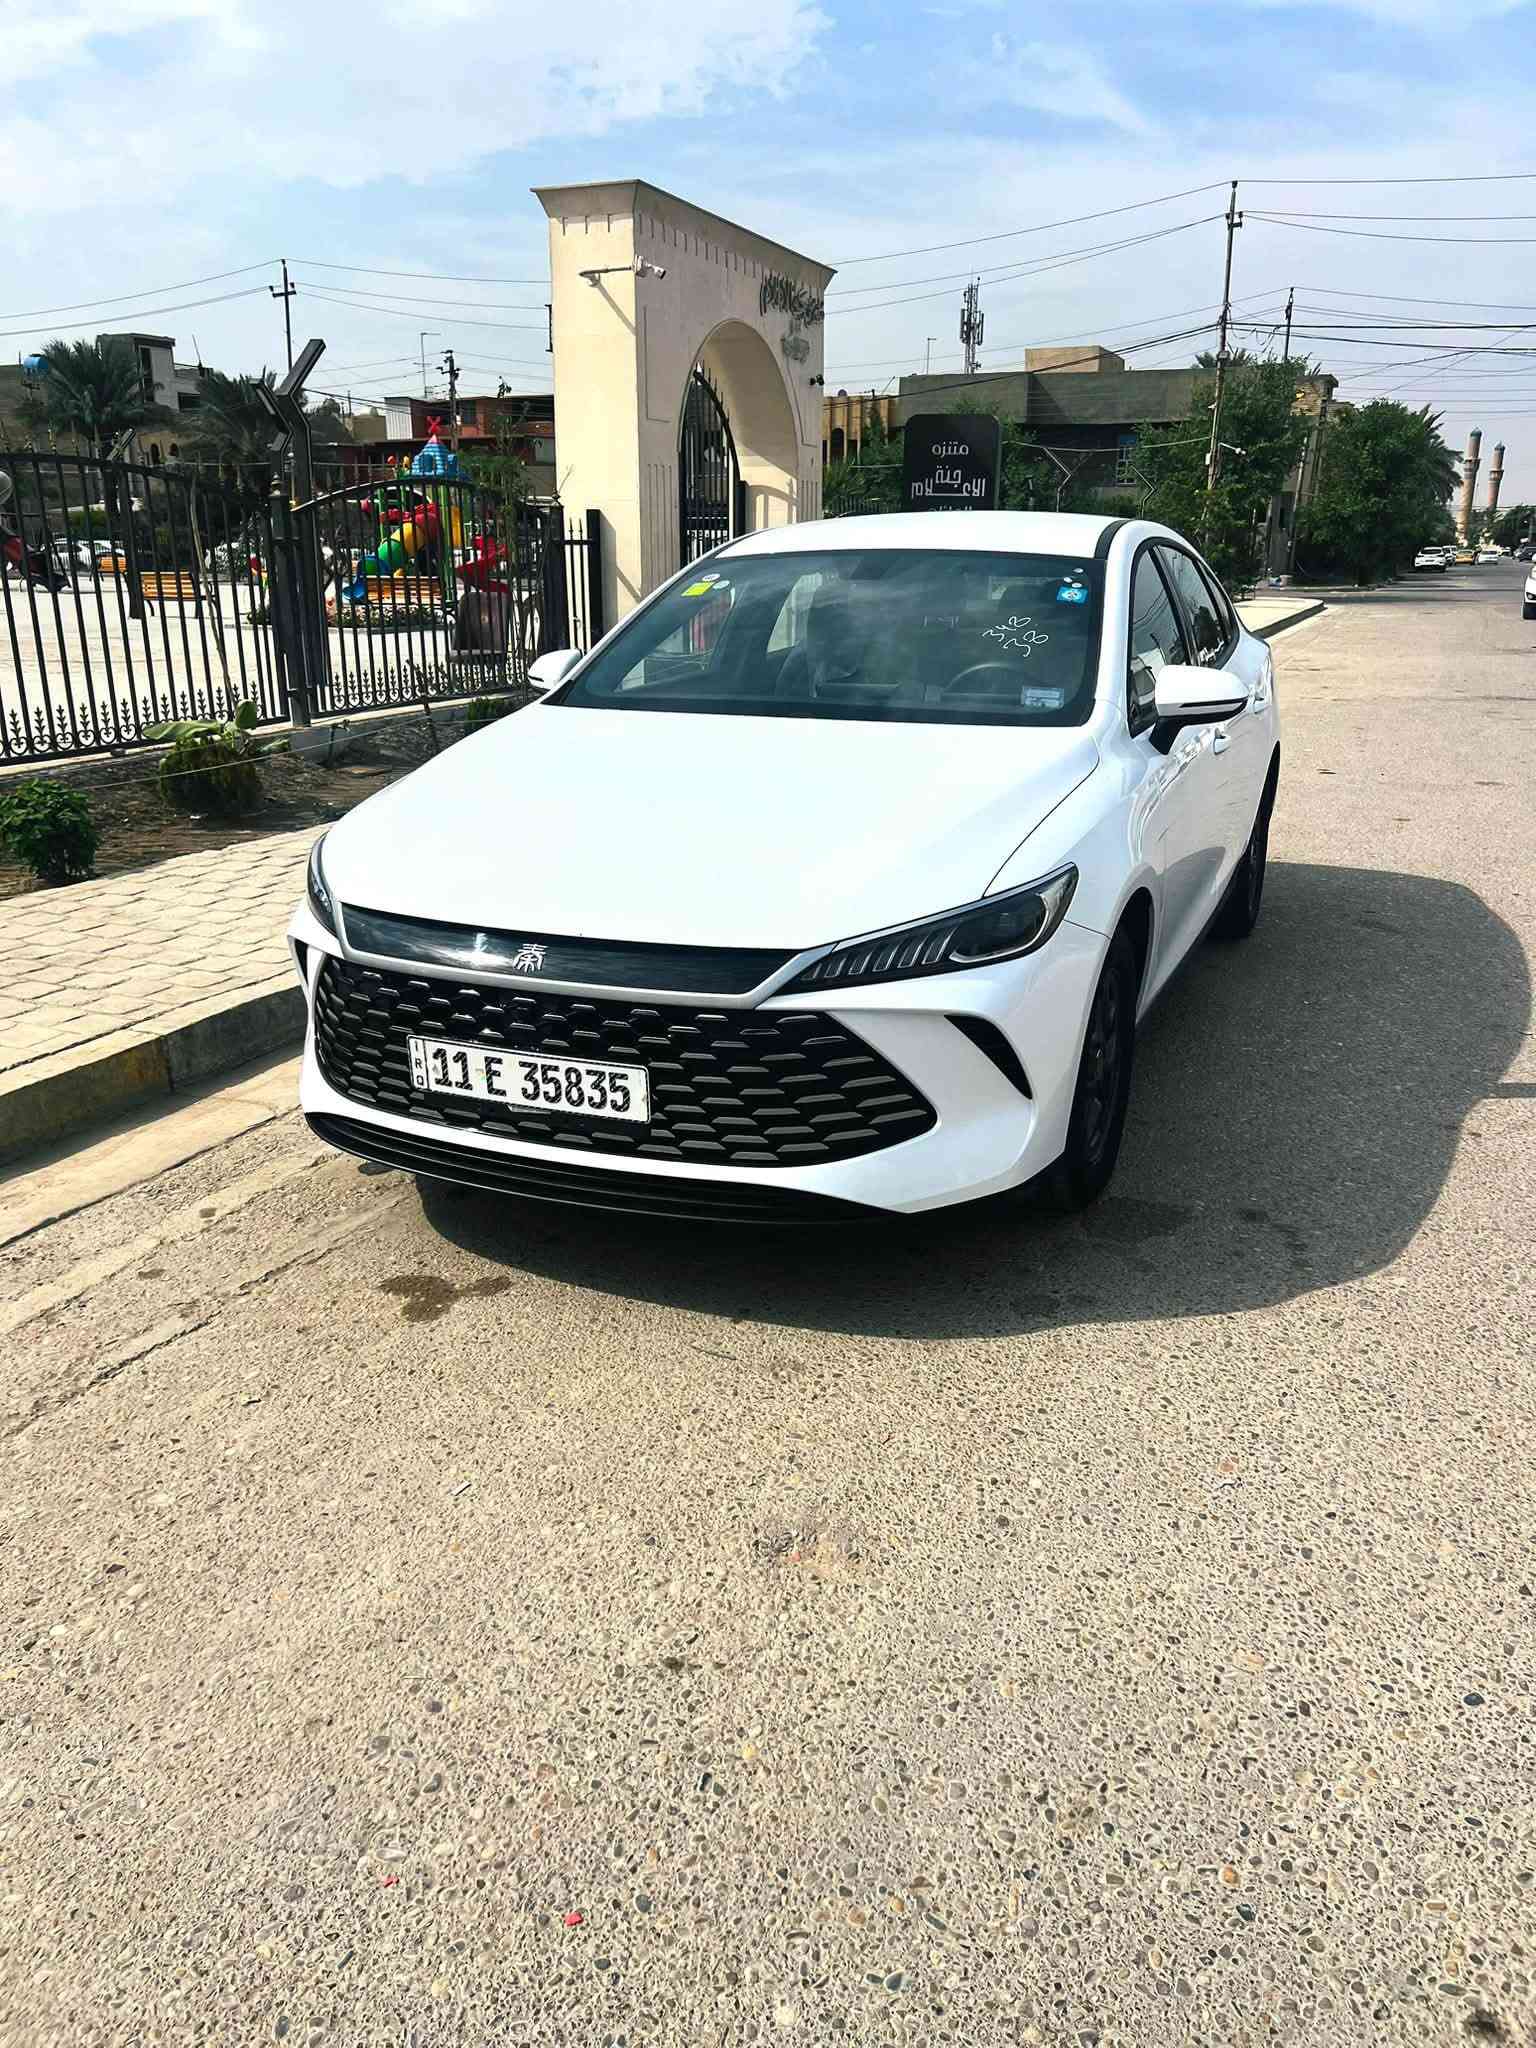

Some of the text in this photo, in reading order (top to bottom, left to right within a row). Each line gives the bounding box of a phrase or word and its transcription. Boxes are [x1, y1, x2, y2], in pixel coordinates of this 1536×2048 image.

[932, 441, 969, 459] متنزه
[935, 465, 962, 488] جنة
[512, 943, 549, 973] 秦
[432, 1048, 631, 1113] 11 E 35835
